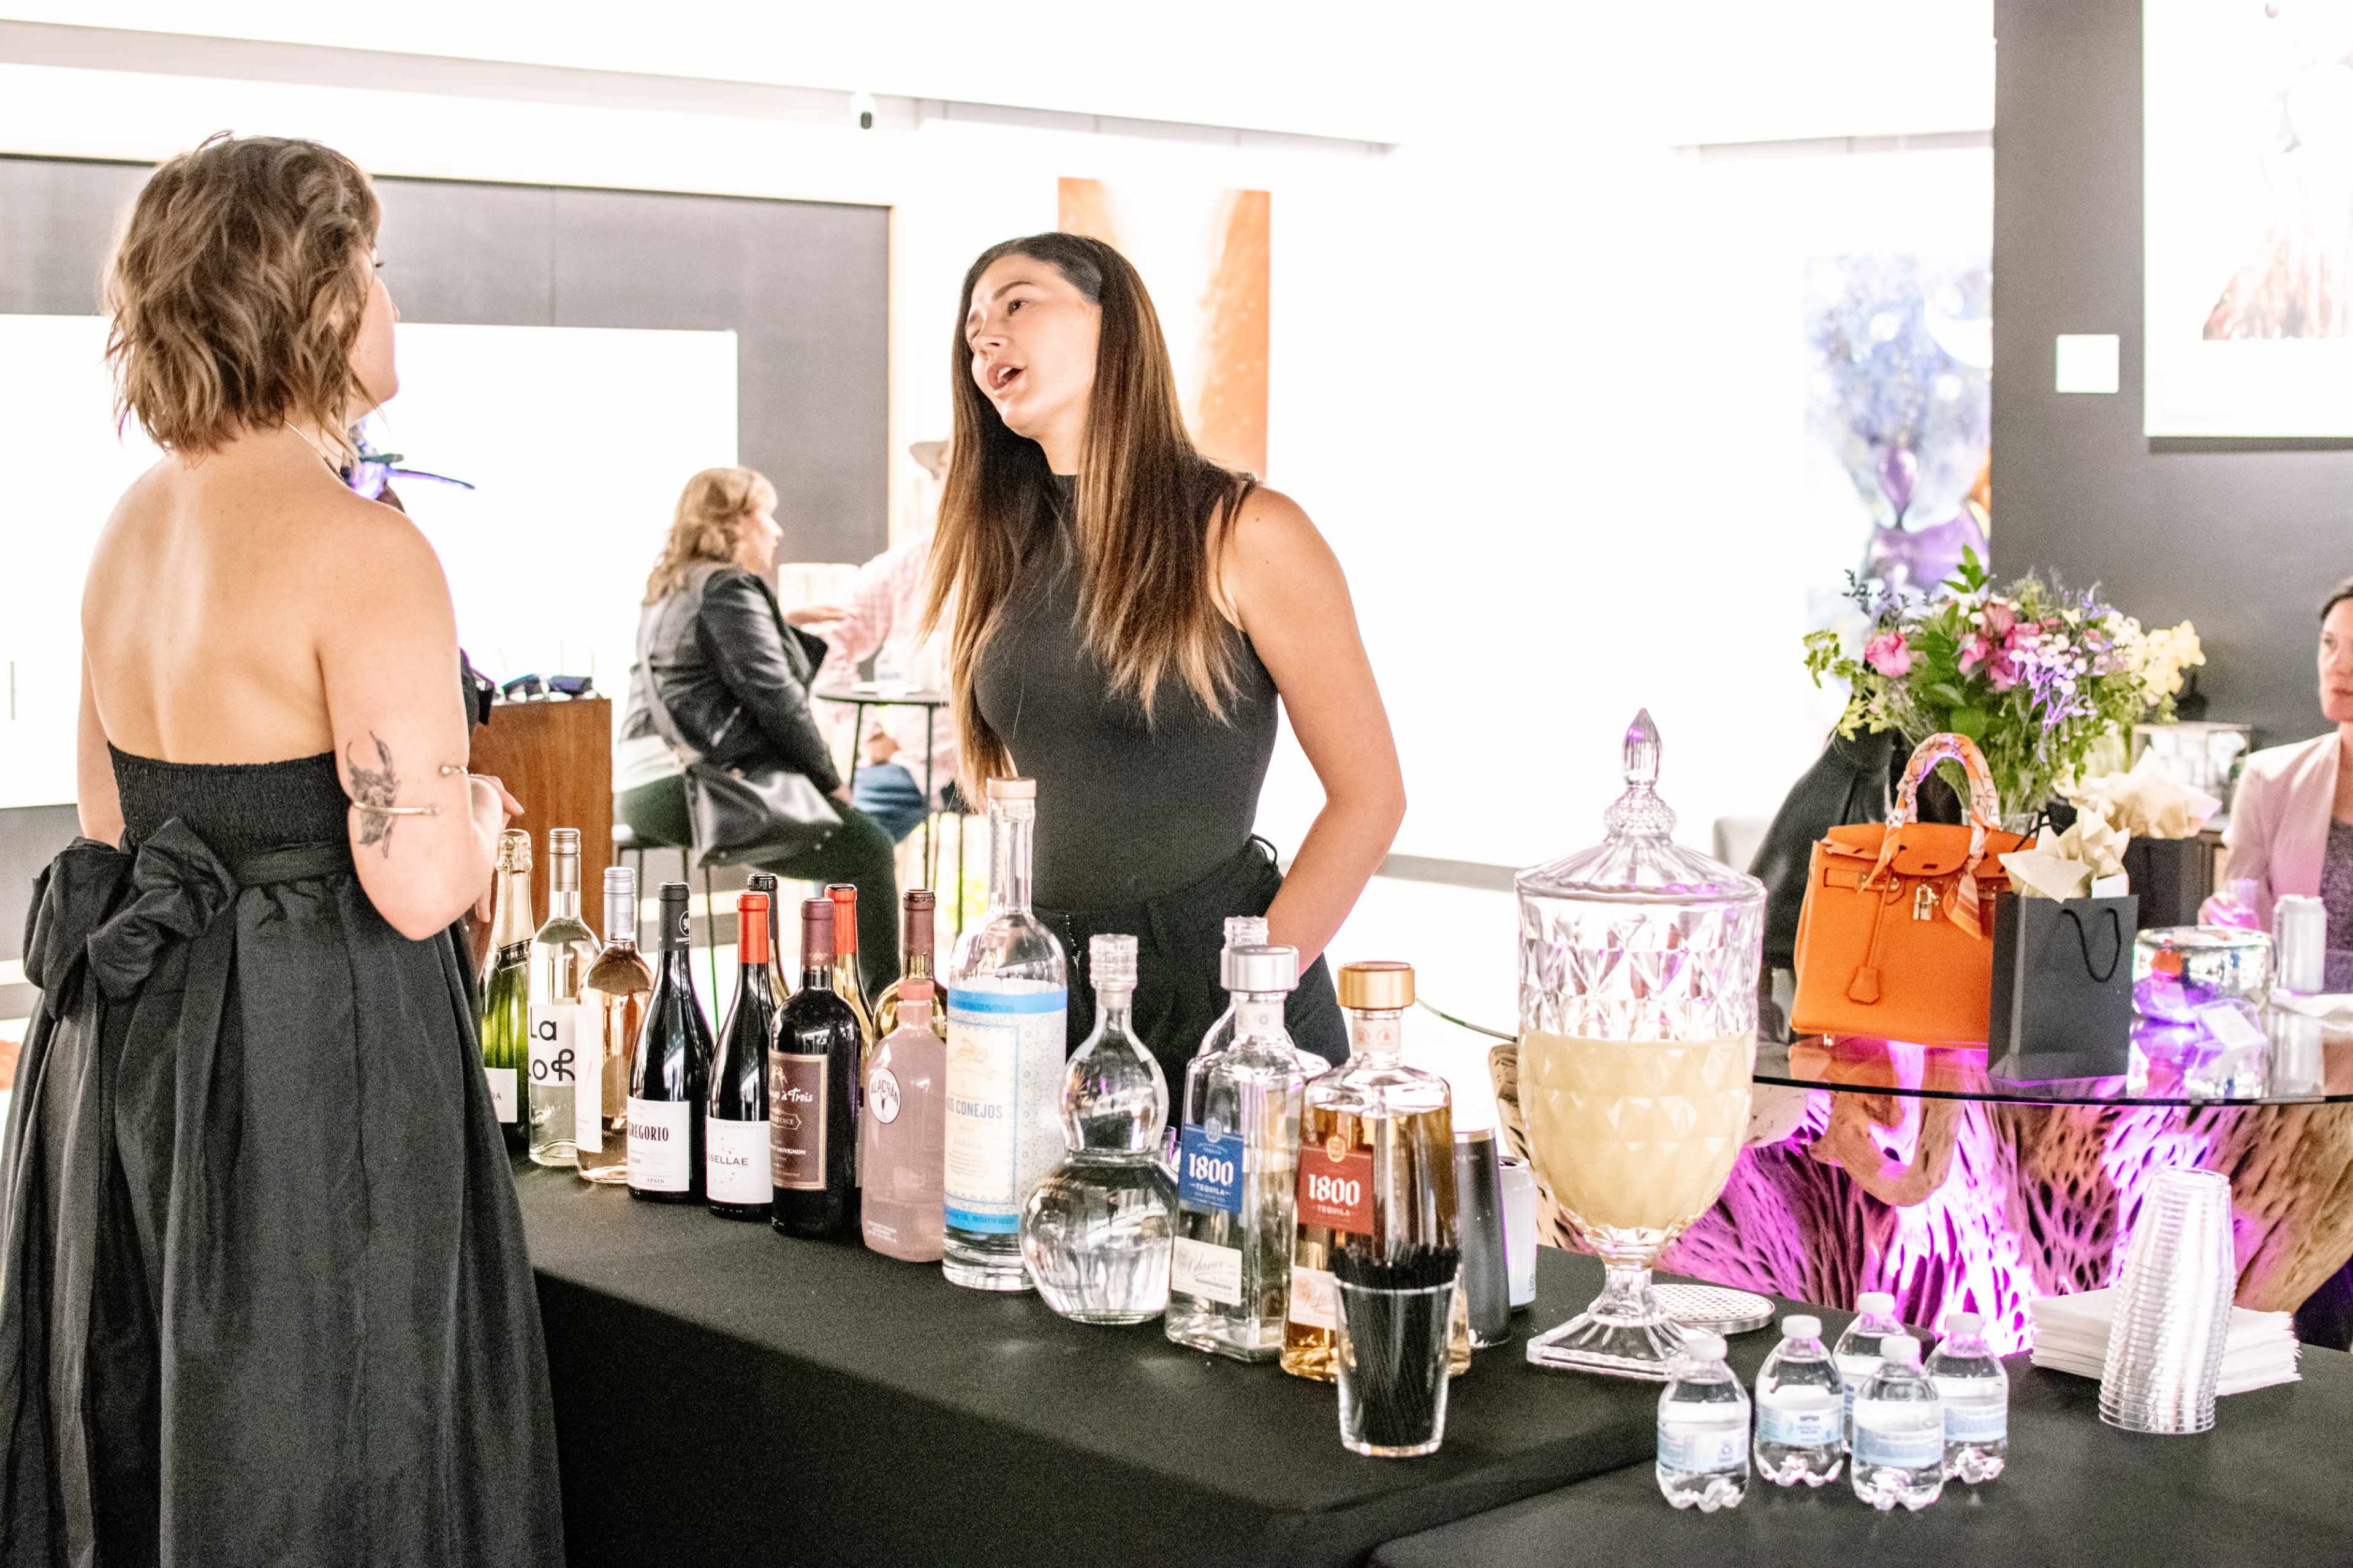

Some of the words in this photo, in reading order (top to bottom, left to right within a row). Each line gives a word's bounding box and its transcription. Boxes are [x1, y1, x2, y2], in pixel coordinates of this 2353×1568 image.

[531, 1006, 557, 1041] La
[787, 1087, 814, 1102] Trois
[956, 1099, 1003, 1120] CONEJOS
[1189, 1153, 1234, 1187] 1800
[1195, 1183, 1226, 1195] TEQUILA
[1308, 1173, 1360, 1206] 1800
[1317, 1204, 1351, 1216] TEQUILA
